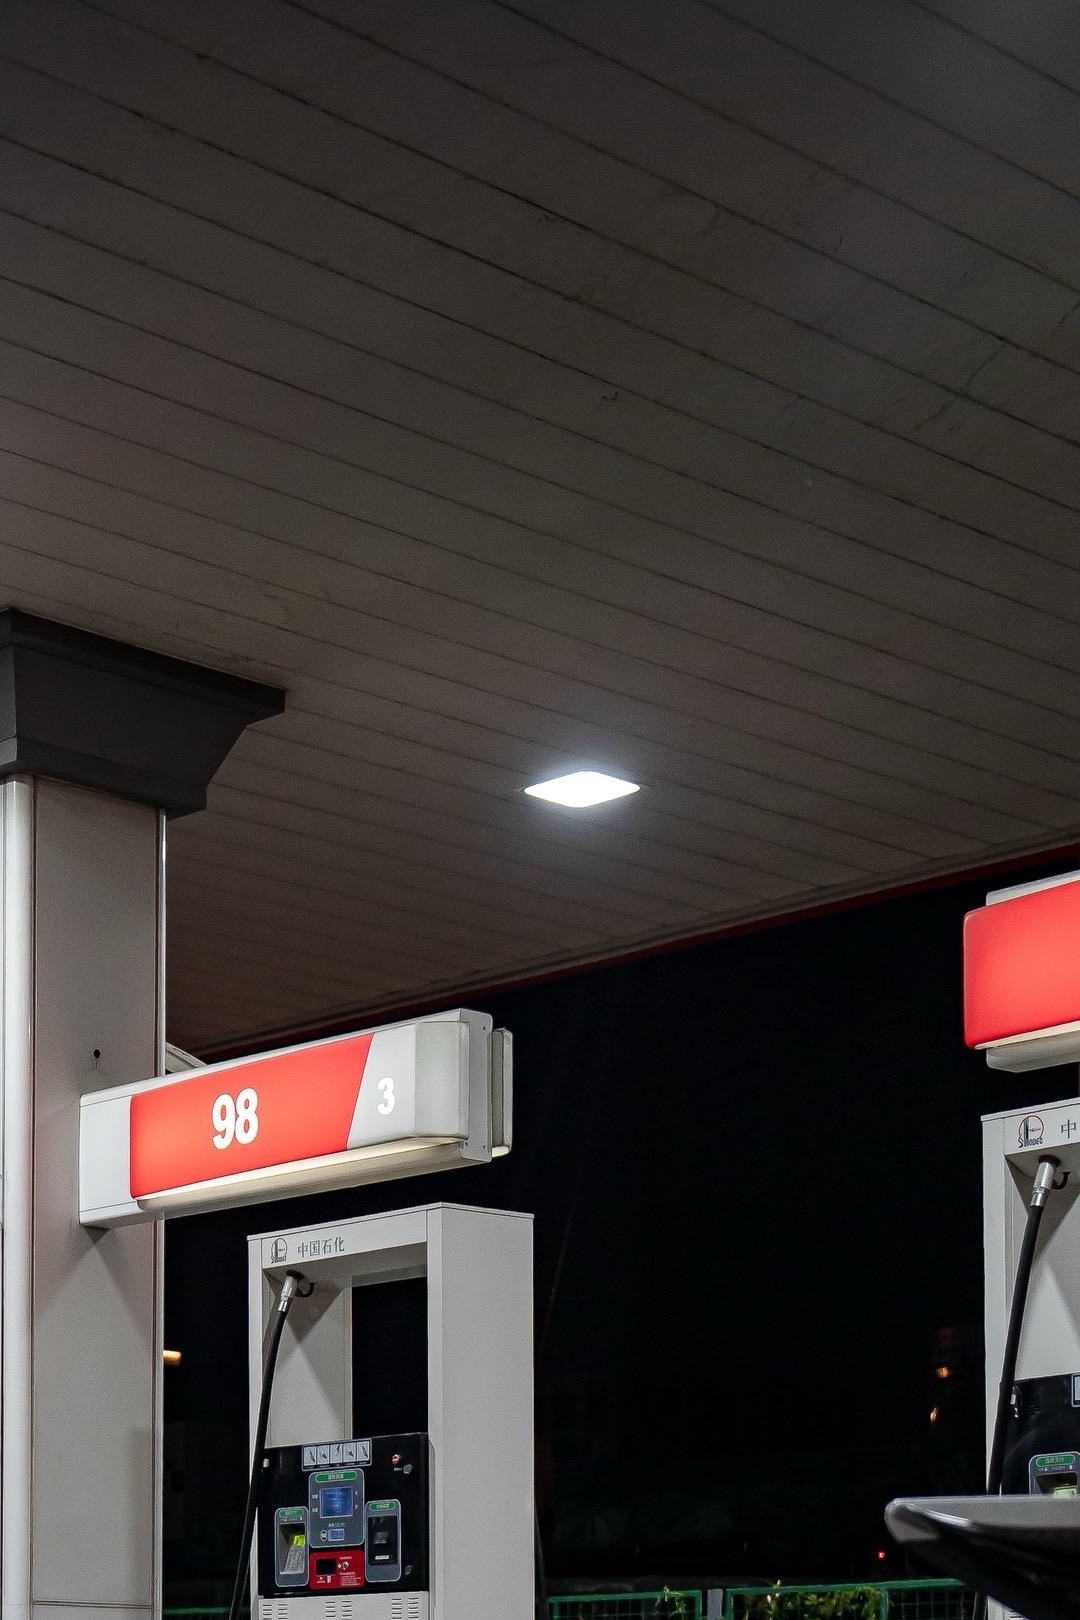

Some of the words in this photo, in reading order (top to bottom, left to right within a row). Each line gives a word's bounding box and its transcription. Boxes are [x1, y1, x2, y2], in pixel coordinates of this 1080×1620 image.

[377, 1076, 395, 1115] 3
[212, 1088, 259, 1150] 98
[297, 1236, 345, 1258] 中国石化
